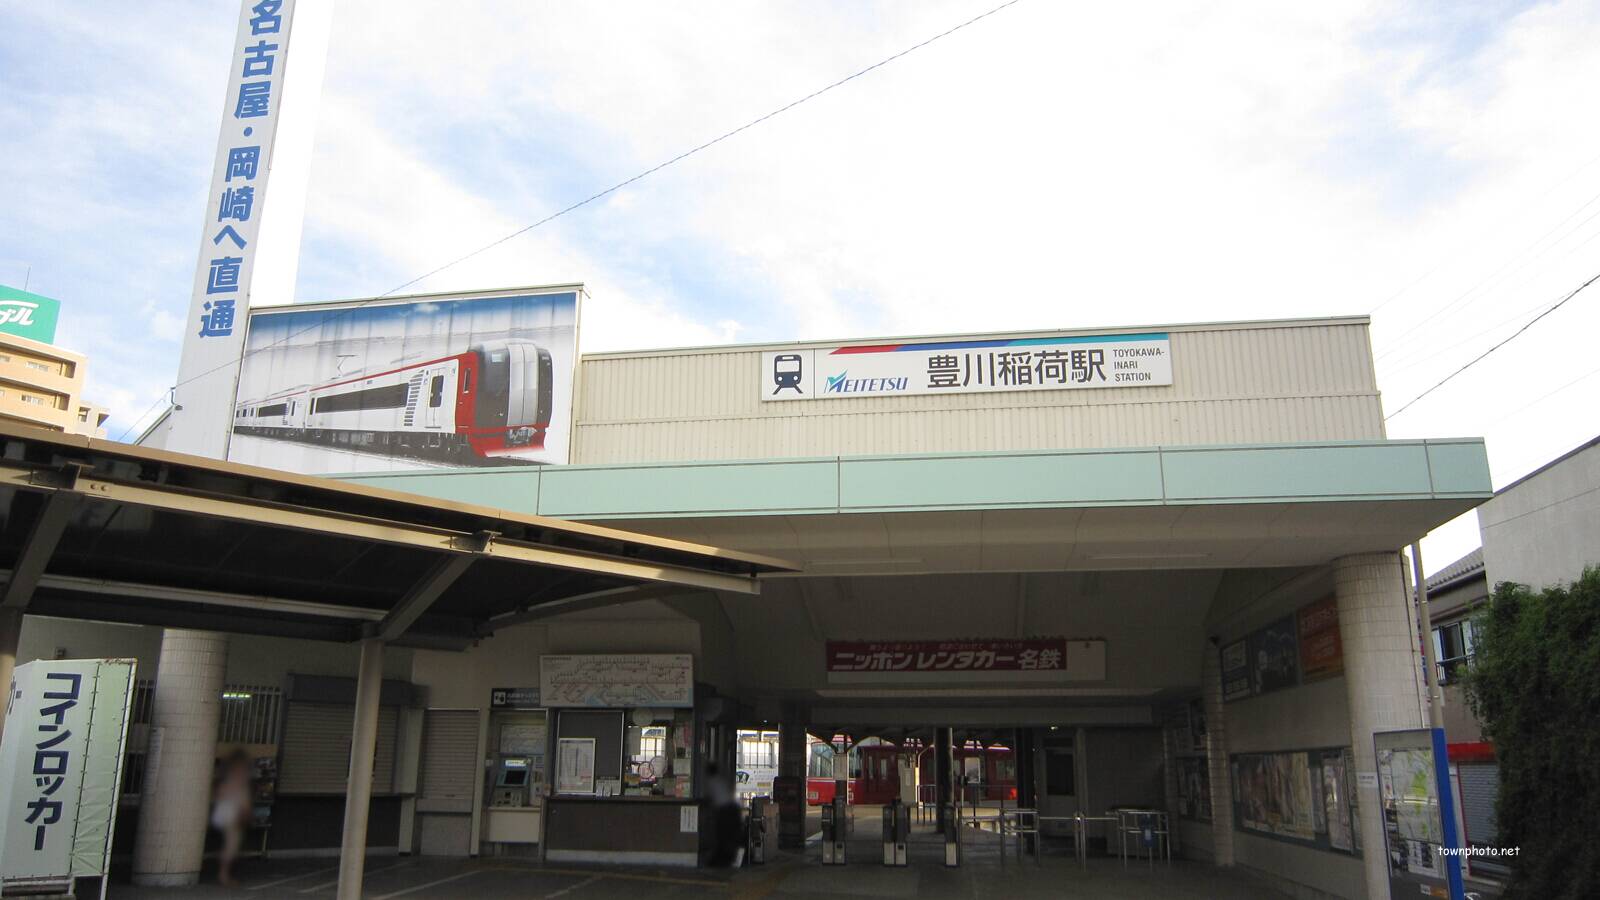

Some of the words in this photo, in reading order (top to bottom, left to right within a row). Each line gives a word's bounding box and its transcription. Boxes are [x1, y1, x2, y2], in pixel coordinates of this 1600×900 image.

[199, 0, 283, 338] 名古屋・岡崎へ直通
[1113, 348, 1165, 358] TOYOKAWA-
[926, 349, 1107, 388] 豊川稲荷駅
[1114, 361, 1138, 370] INARI
[824, 369, 908, 393] MEITETSU
[1115, 372, 1151, 382] STATION
[832, 652, 912, 670] ニッポン
[917, 650, 1015, 668] レンタカー
[1018, 649, 1060, 669] 名鉄
[25, 672, 82, 851] コインロッカー
